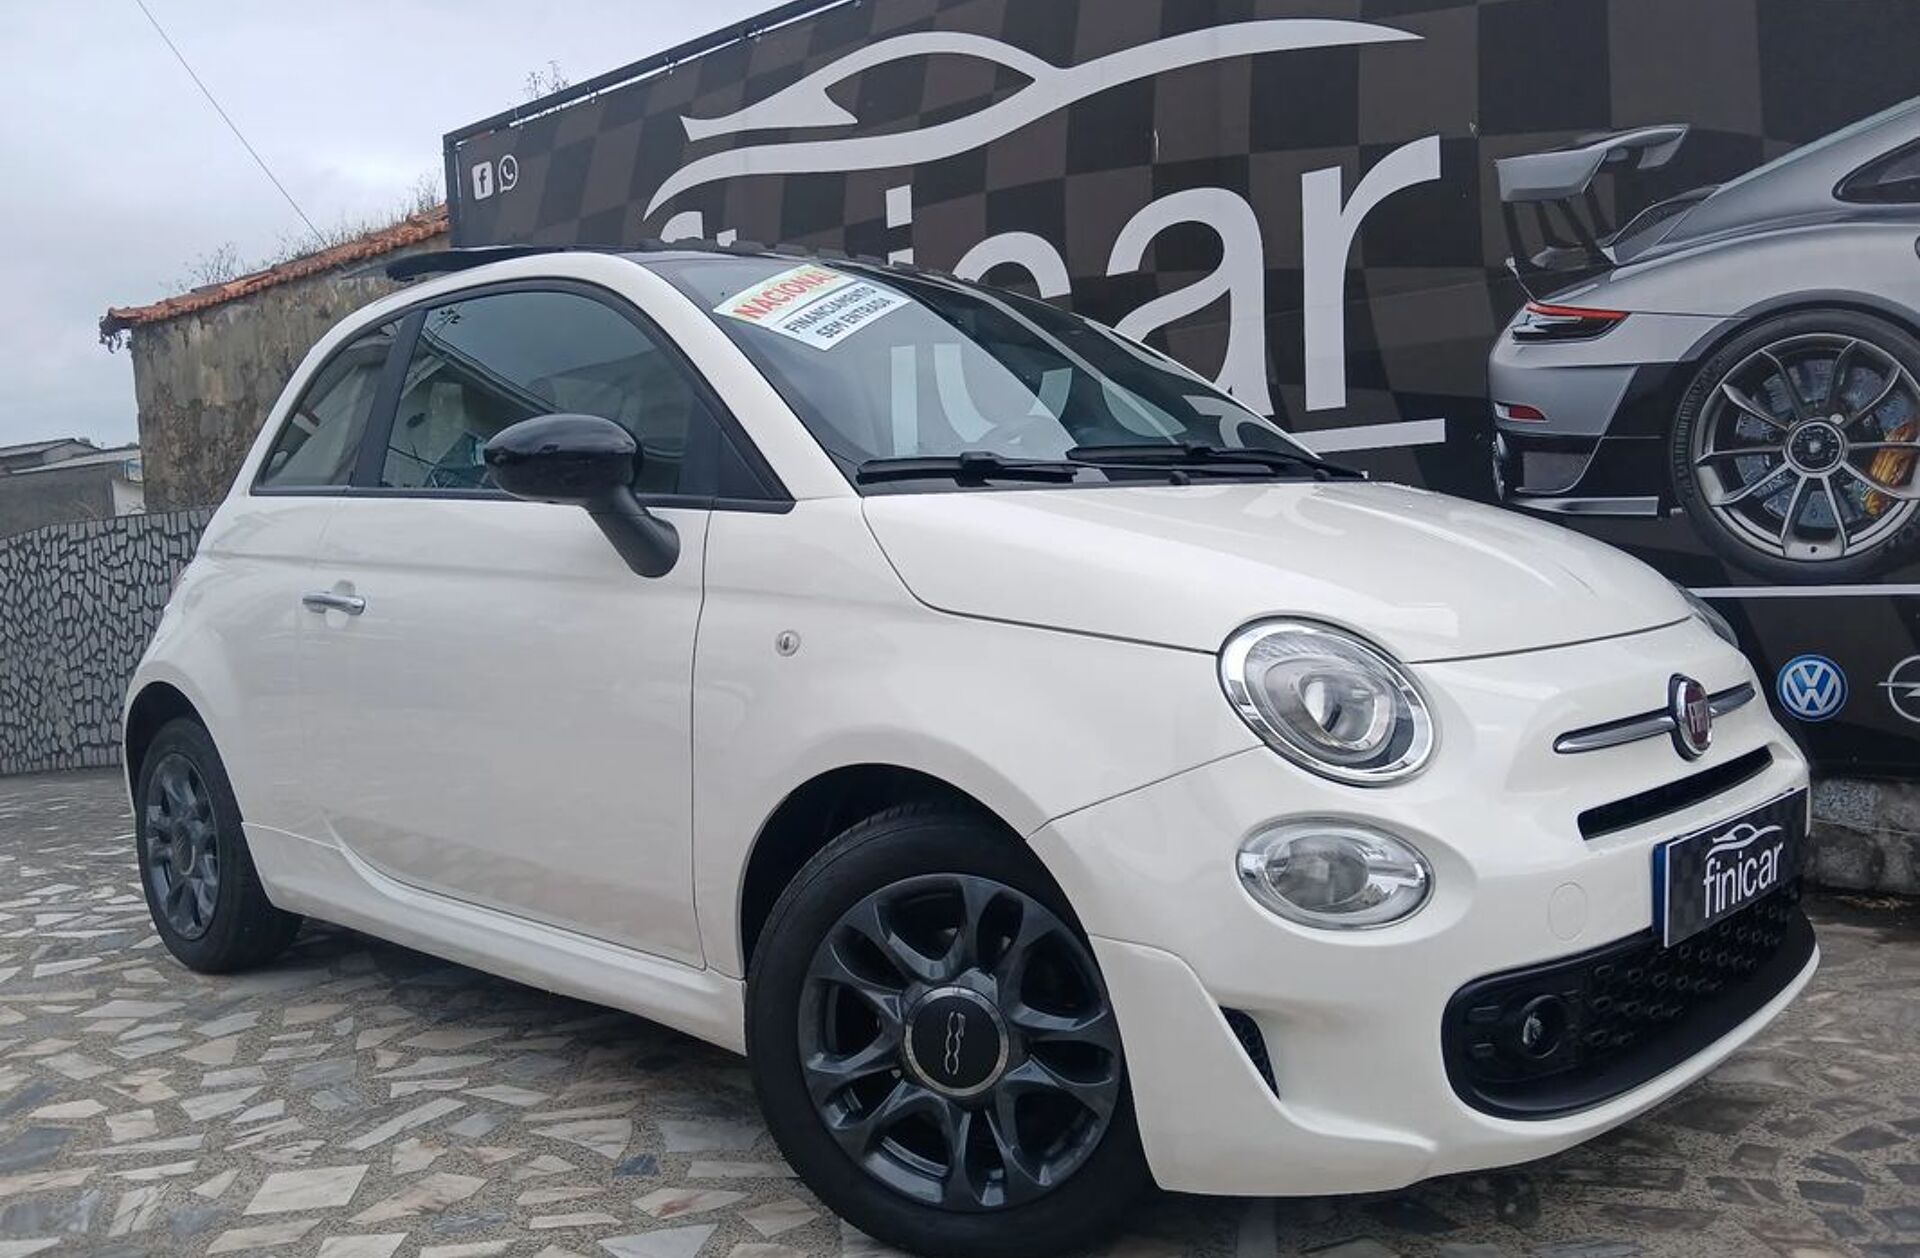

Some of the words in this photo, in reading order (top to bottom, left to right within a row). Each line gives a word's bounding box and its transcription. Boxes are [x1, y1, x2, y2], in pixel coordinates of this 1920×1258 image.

[660, 135, 1442, 456] icar
[733, 270, 840, 320] NACIONAL
[784, 284, 878, 334] FINANCIAMENTO
[815, 315, 849, 339] SEM
[847, 297, 895, 327] ENTRADA
[1703, 842, 1784, 919] finicar
